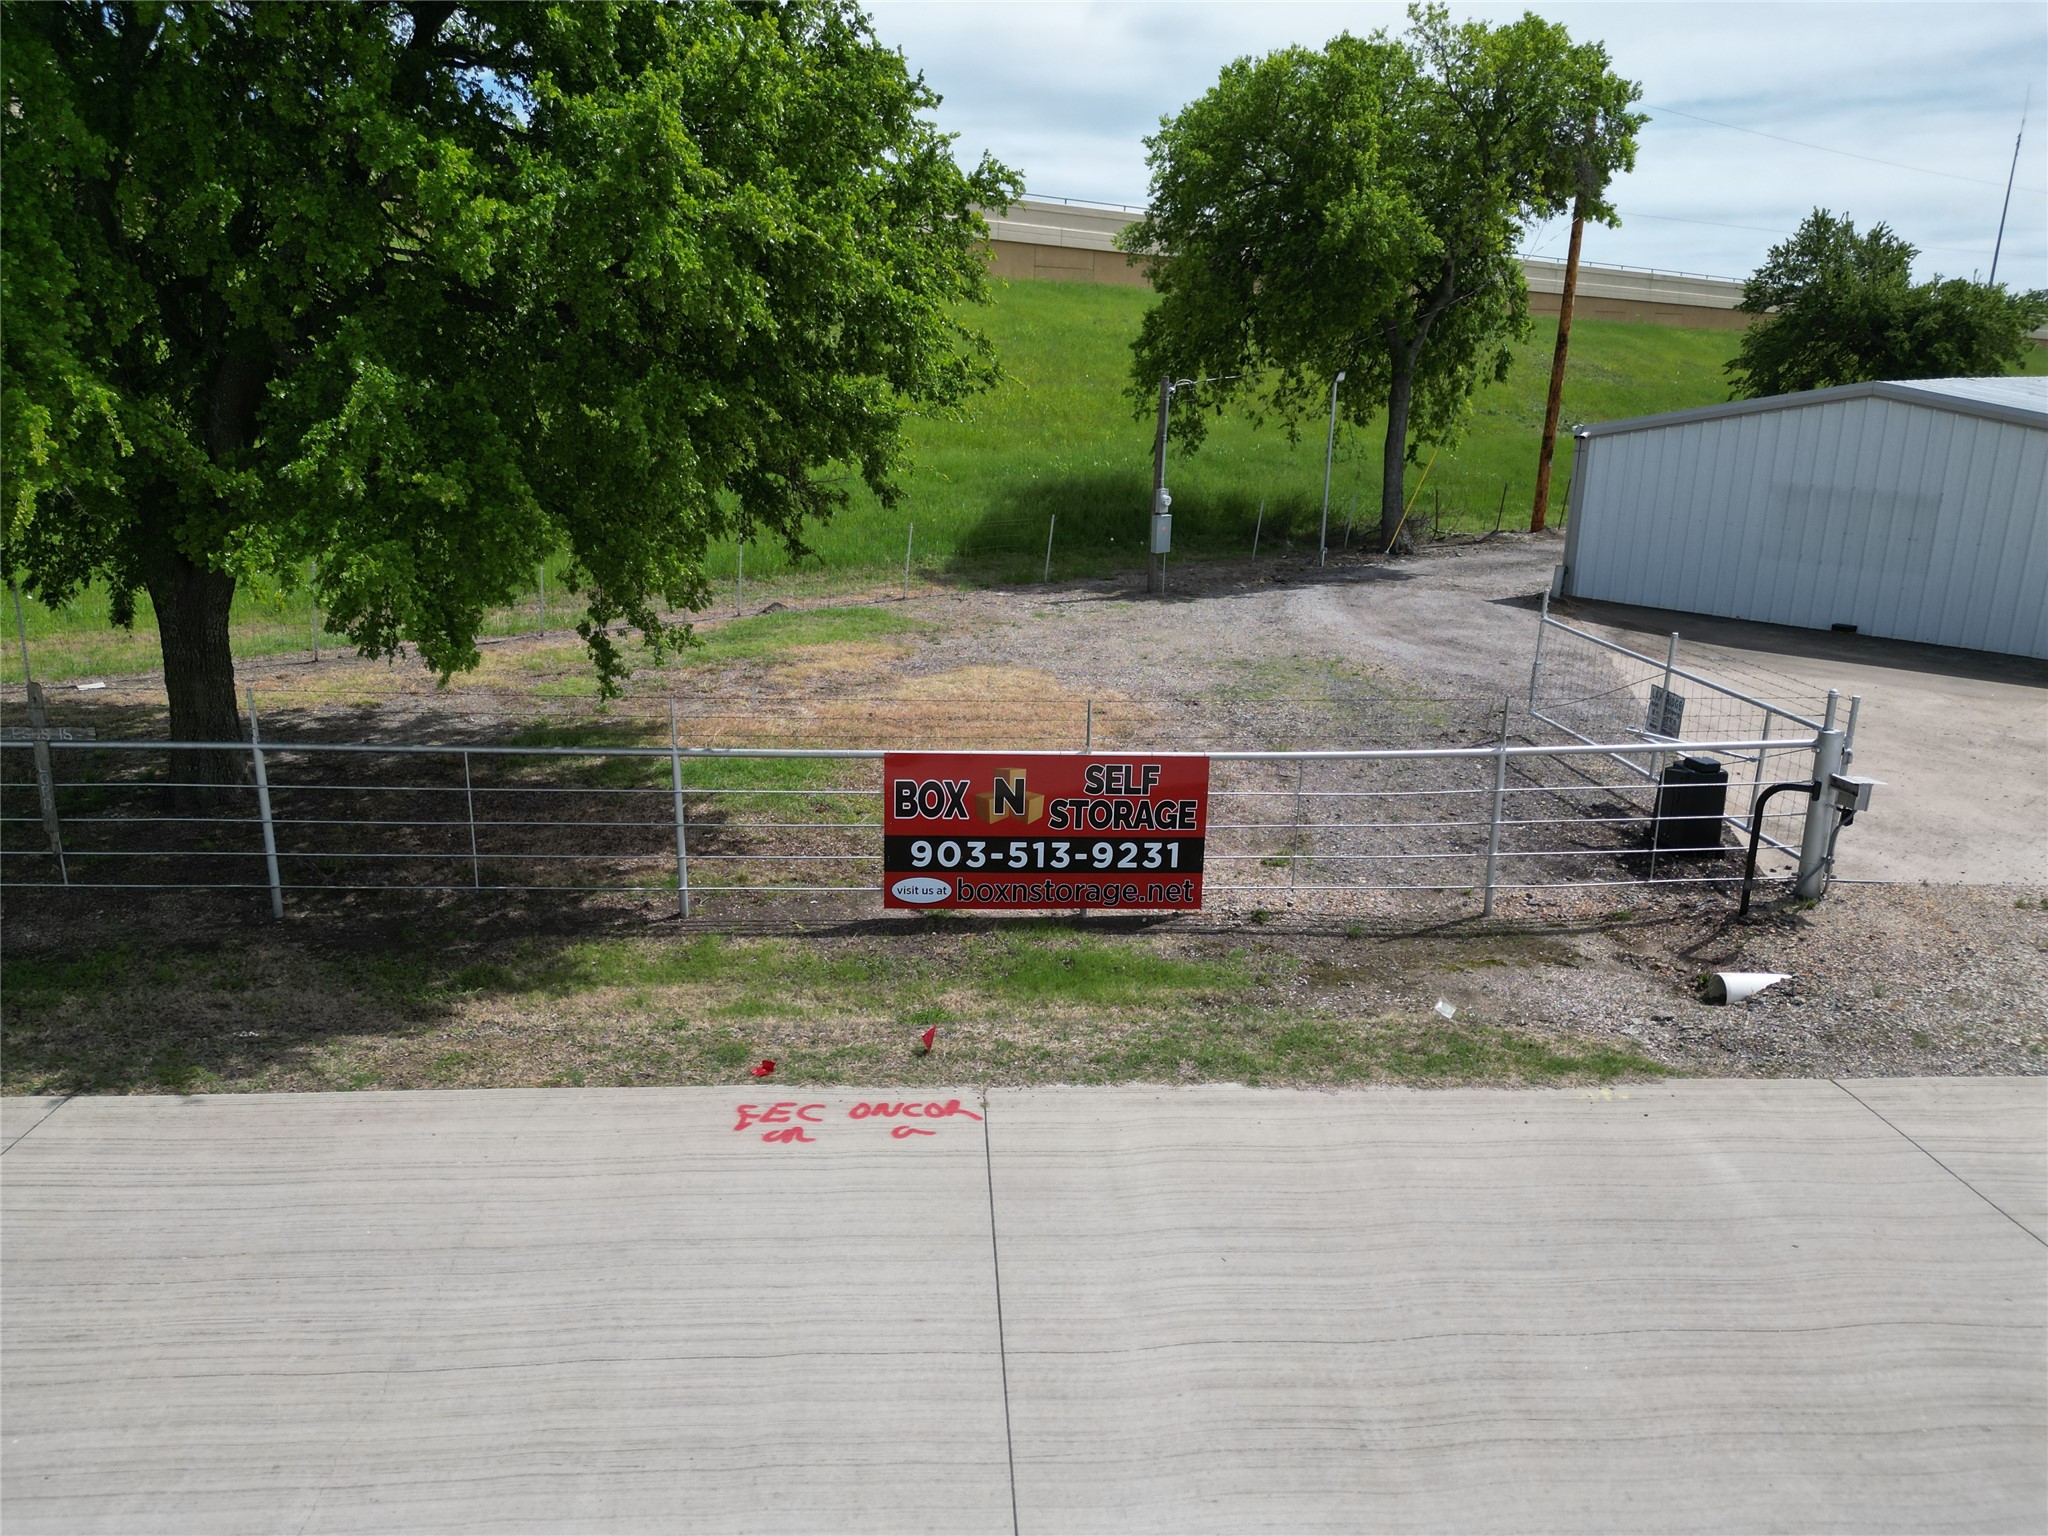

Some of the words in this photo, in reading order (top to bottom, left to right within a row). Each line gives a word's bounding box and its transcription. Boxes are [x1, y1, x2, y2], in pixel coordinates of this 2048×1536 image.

[1084, 764, 1161, 796] SELF
[894, 779, 970, 819] BOX
[993, 777, 1027, 815] N
[1048, 799, 1198, 831] STORAGE
[910, 840, 1179, 868] 903-513-9231
[896, 885, 919, 895] visit
[921, 887, 934, 895] us
[936, 886, 948, 895] at
[956, 877, 1194, 906] boxnstorage.net
[847, 1098, 984, 1121] ONCOR
